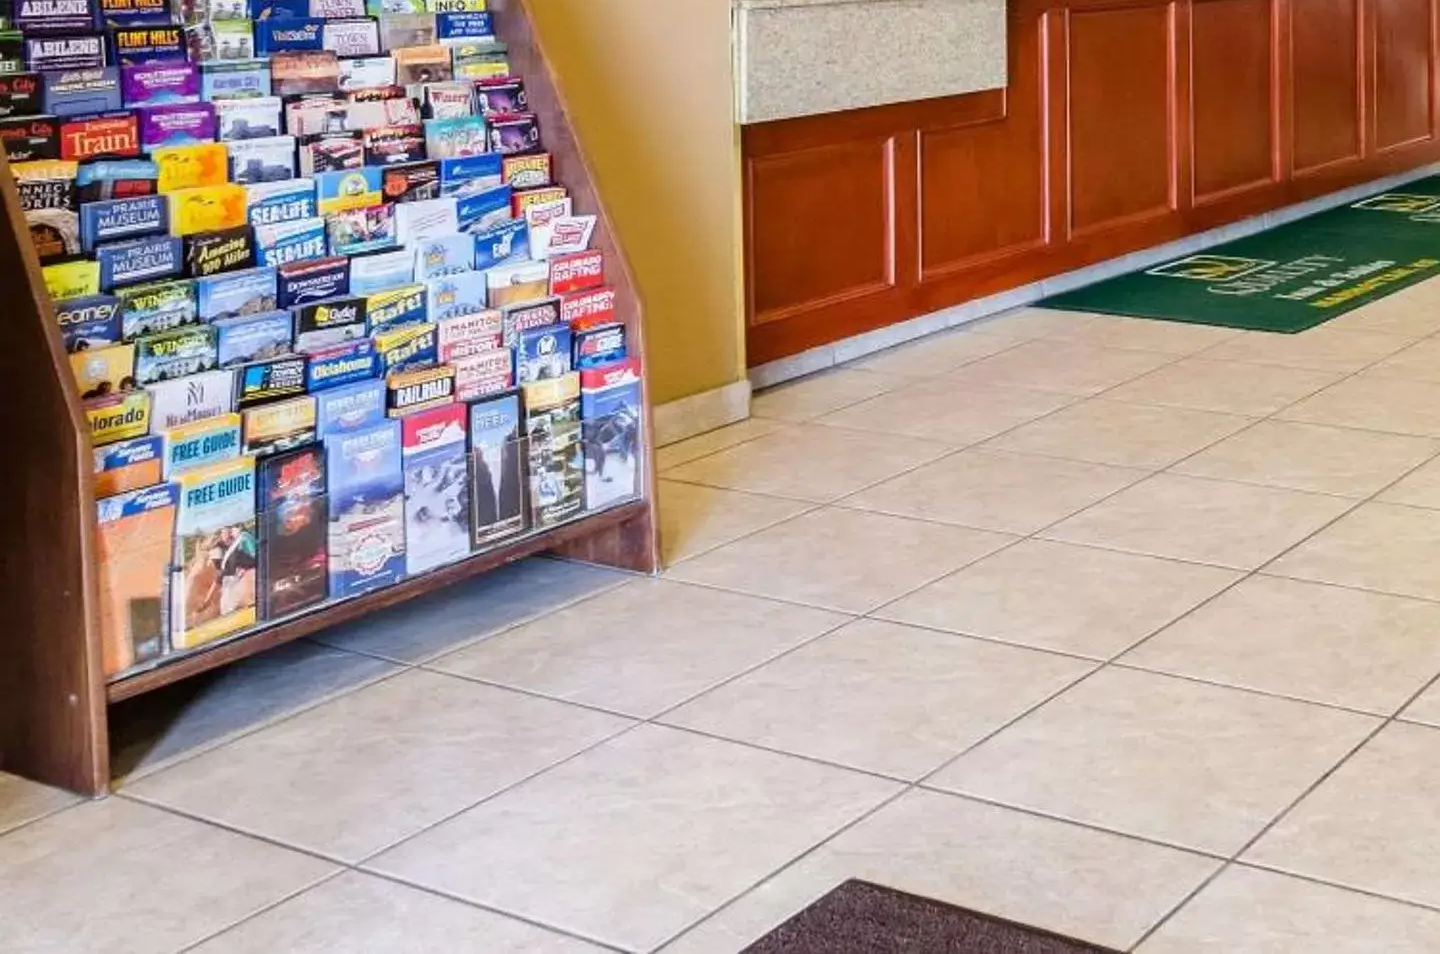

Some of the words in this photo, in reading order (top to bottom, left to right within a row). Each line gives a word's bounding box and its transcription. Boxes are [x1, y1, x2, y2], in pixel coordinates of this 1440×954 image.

[21, 0, 88, 16] ABILENE
[435, 0, 466, 12] INFO
[32, 38, 99, 58] ABILENE
[118, 31, 148, 47] FLINT
[151, 30, 179, 45] HILLS
[66, 126, 139, 157] Train!
[17, 182, 70, 195] NNECT
[98, 210, 160, 228] MUSEUM
[113, 254, 174, 274] MUSEUM
[554, 255, 602, 271] COLORADO
[564, 291, 616, 309] COLORADO
[57, 302, 119, 326] earney
[396, 377, 450, 407] RAILROAD
[91, 407, 145, 430] lorado
[172, 441, 200, 462] FREE
[202, 430, 237, 454] GUIDE
[187, 482, 215, 507] FREE
[218, 473, 251, 499] GUIDE
